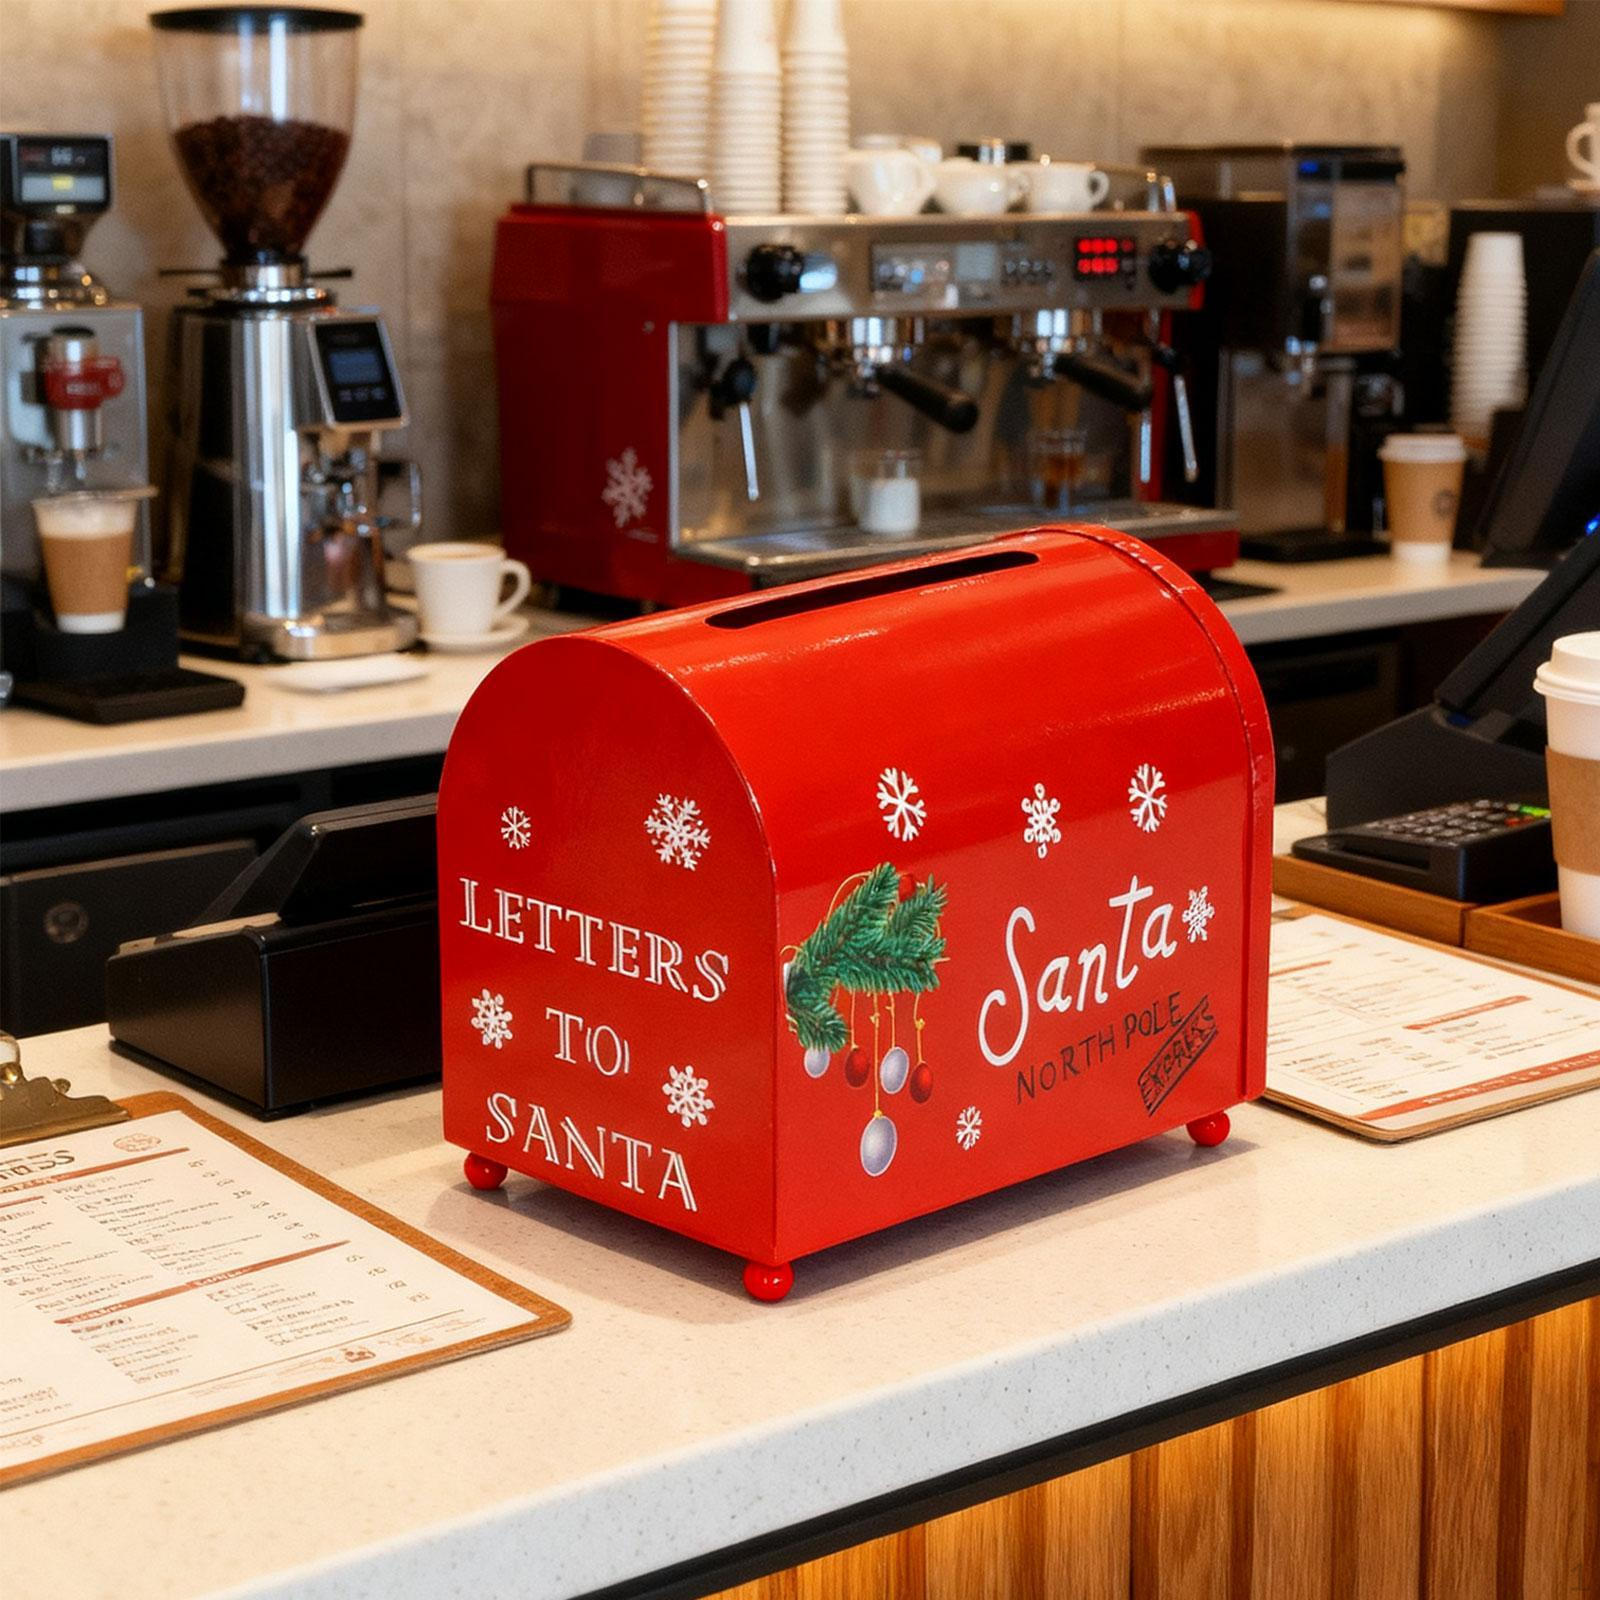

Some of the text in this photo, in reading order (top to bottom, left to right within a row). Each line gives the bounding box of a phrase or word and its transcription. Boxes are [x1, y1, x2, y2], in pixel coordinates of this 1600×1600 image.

[459, 877, 729, 1002] LETTERS
[978, 875, 1178, 1066] Santa
[546, 1007, 630, 1076] TO
[1017, 991, 1183, 1105] NORTH POLE
[486, 1092, 698, 1212] SANTA
